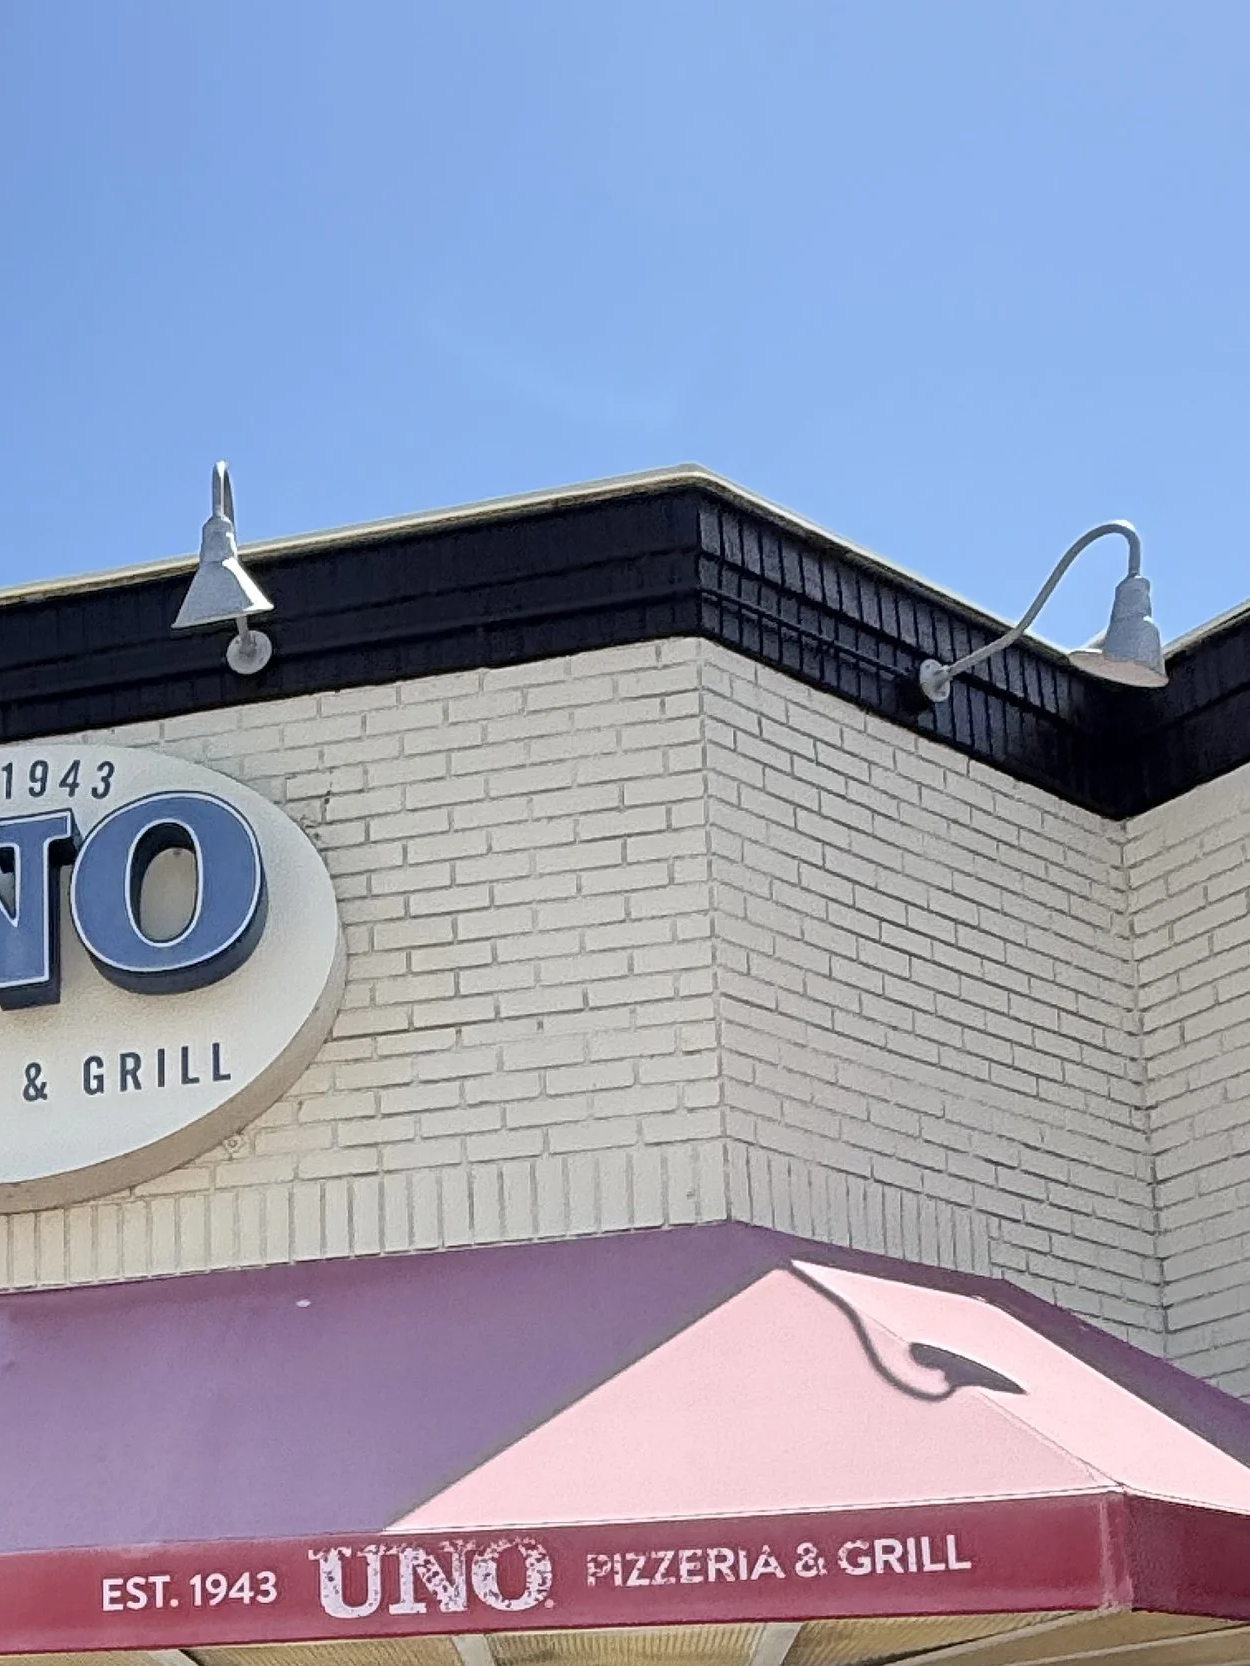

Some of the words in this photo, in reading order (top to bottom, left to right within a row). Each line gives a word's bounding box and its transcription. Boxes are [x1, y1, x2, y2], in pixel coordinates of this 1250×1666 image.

[2, 759, 117, 799] 1943
[24, 1061, 48, 1102] &
[83, 1041, 232, 1094] GRILL
[101, 1573, 178, 1613] EST.
[190, 1570, 278, 1608] 1943
[307, 1538, 551, 1620] UNO
[586, 1544, 786, 1588] PIZZERIA
[795, 1543, 826, 1578] &
[838, 1534, 972, 1576] GRILL
